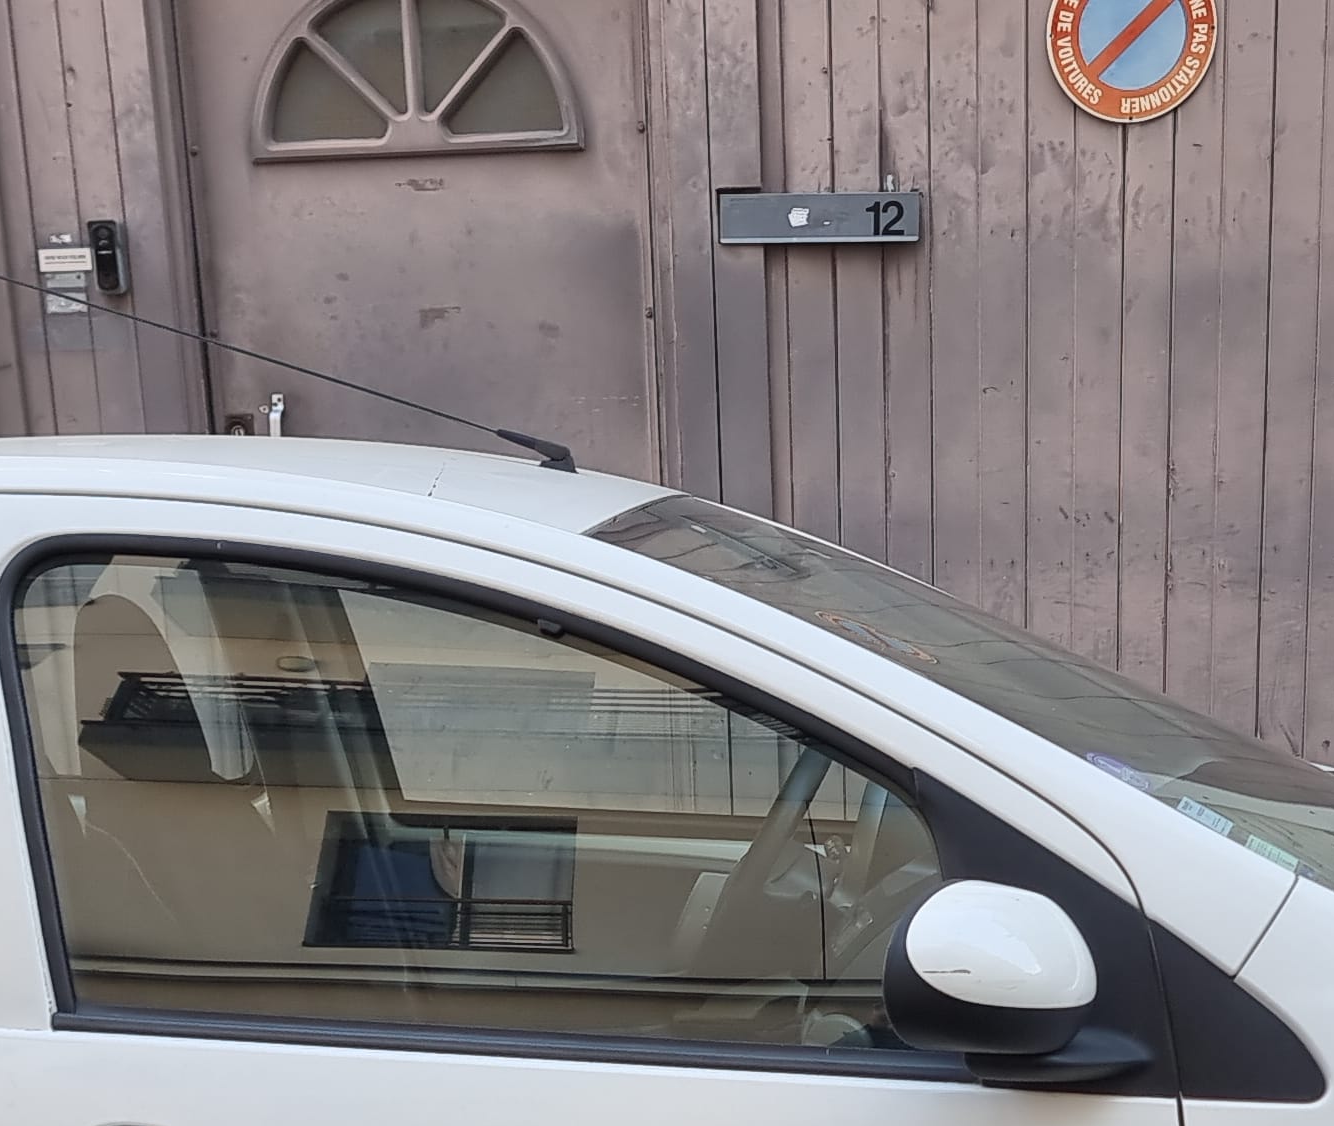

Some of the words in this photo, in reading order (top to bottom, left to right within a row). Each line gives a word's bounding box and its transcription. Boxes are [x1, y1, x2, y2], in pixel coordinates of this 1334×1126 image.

[1057, 10, 1075, 32] DE
[1188, 0, 1207, 20] NE
[1191, 24, 1209, 54] PAS
[1057, 36, 1102, 105] VOITURES
[1121, 56, 1200, 114] STATIONNER
[865, 201, 905, 236] 12
